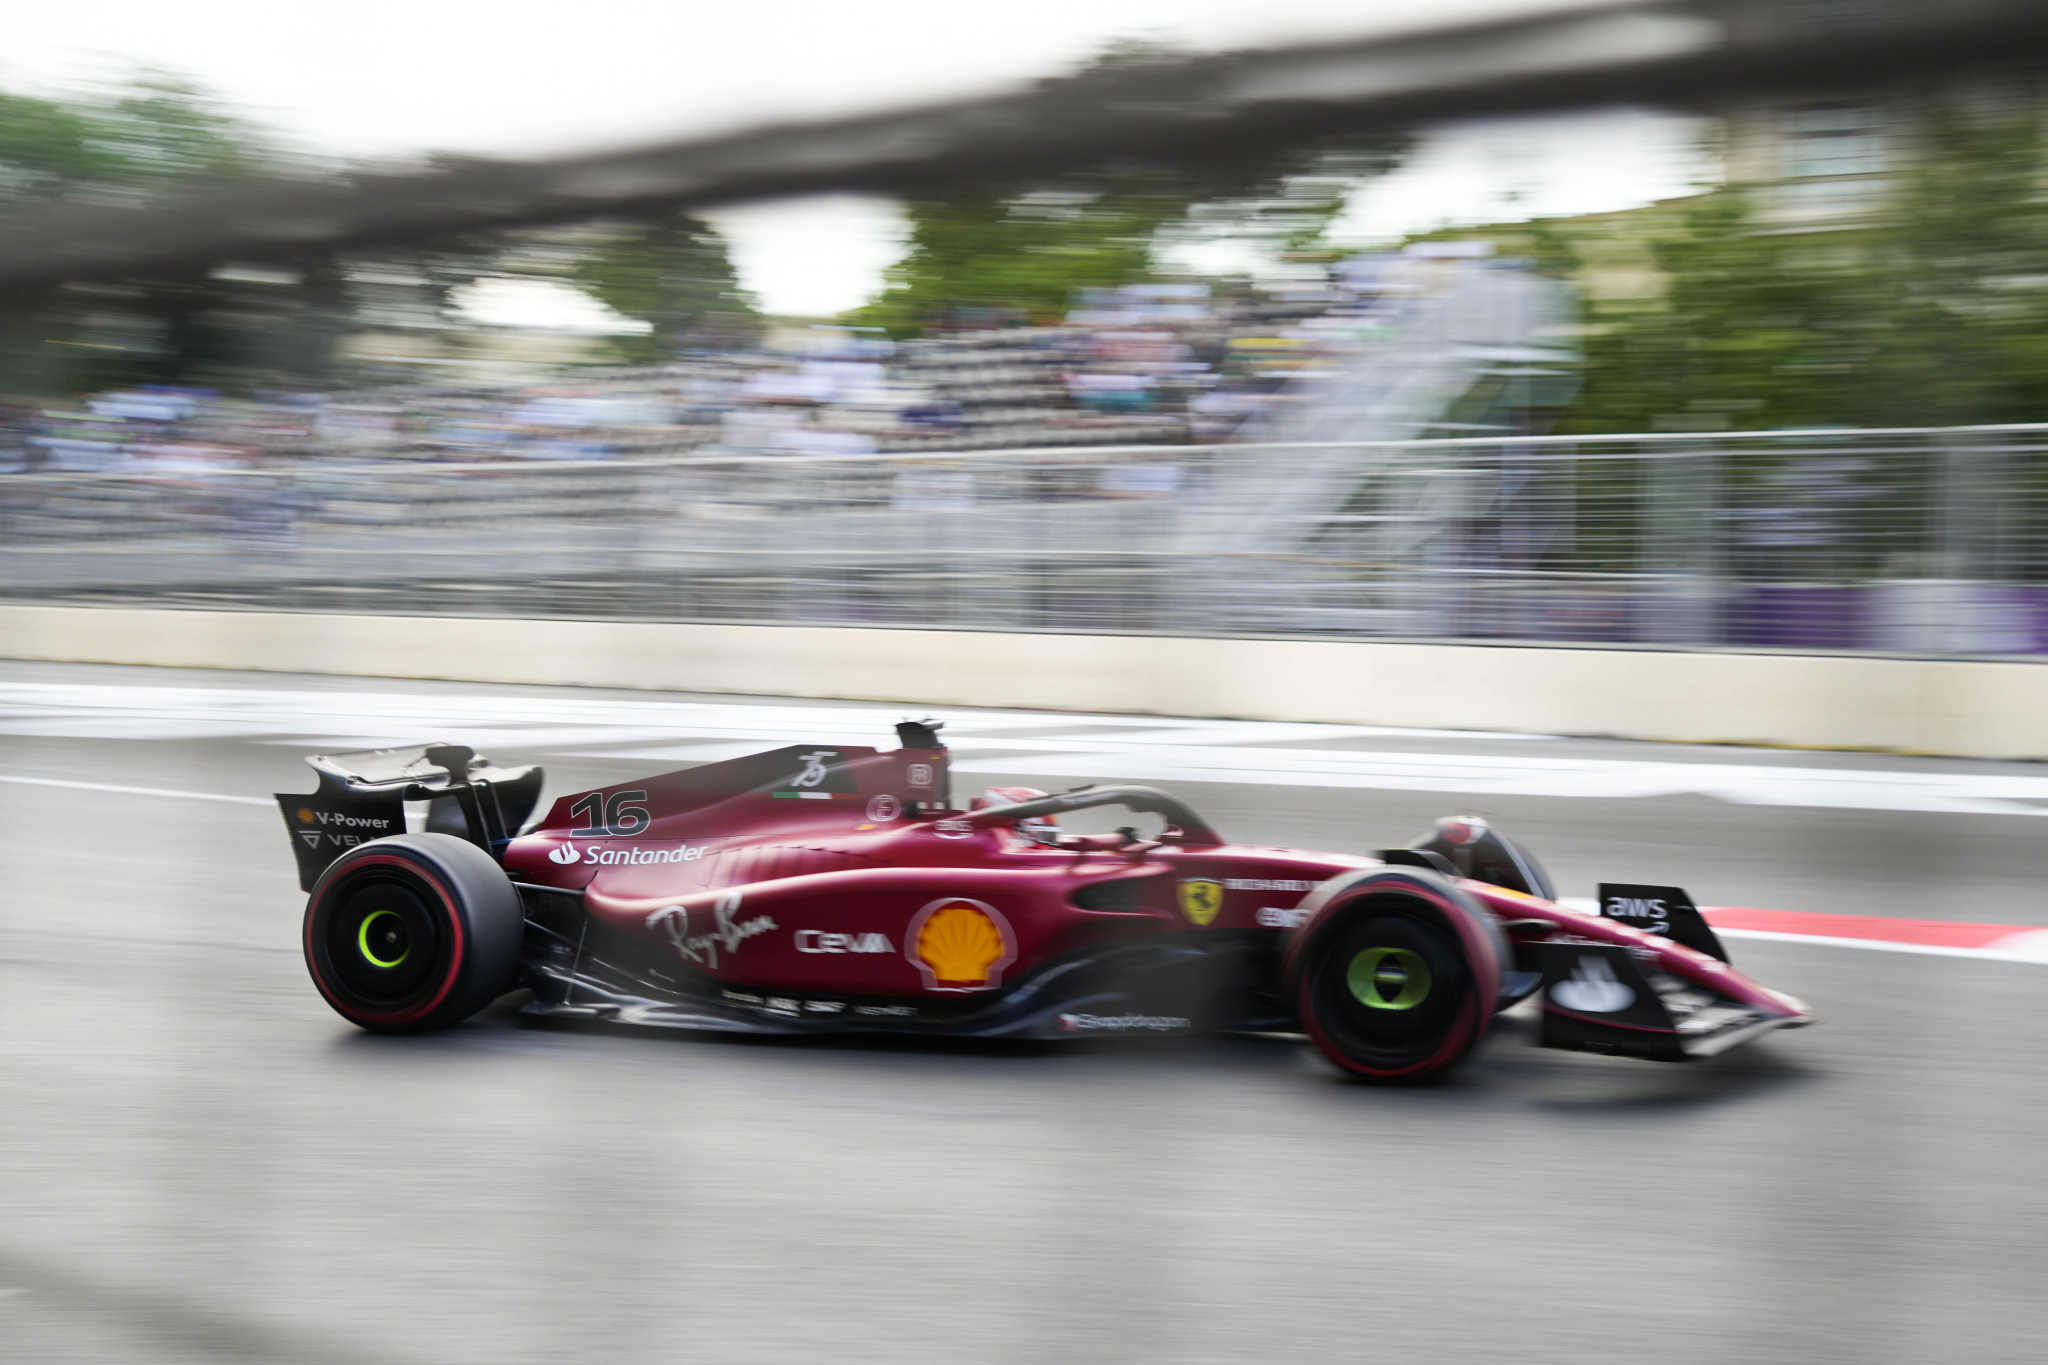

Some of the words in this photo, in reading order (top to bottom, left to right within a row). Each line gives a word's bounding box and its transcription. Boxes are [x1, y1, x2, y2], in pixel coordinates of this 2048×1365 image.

[315, 811, 390, 829] V-Power
[569, 789, 651, 838] 16
[584, 845, 709, 866] Santander
[1606, 896, 1668, 919] aws
